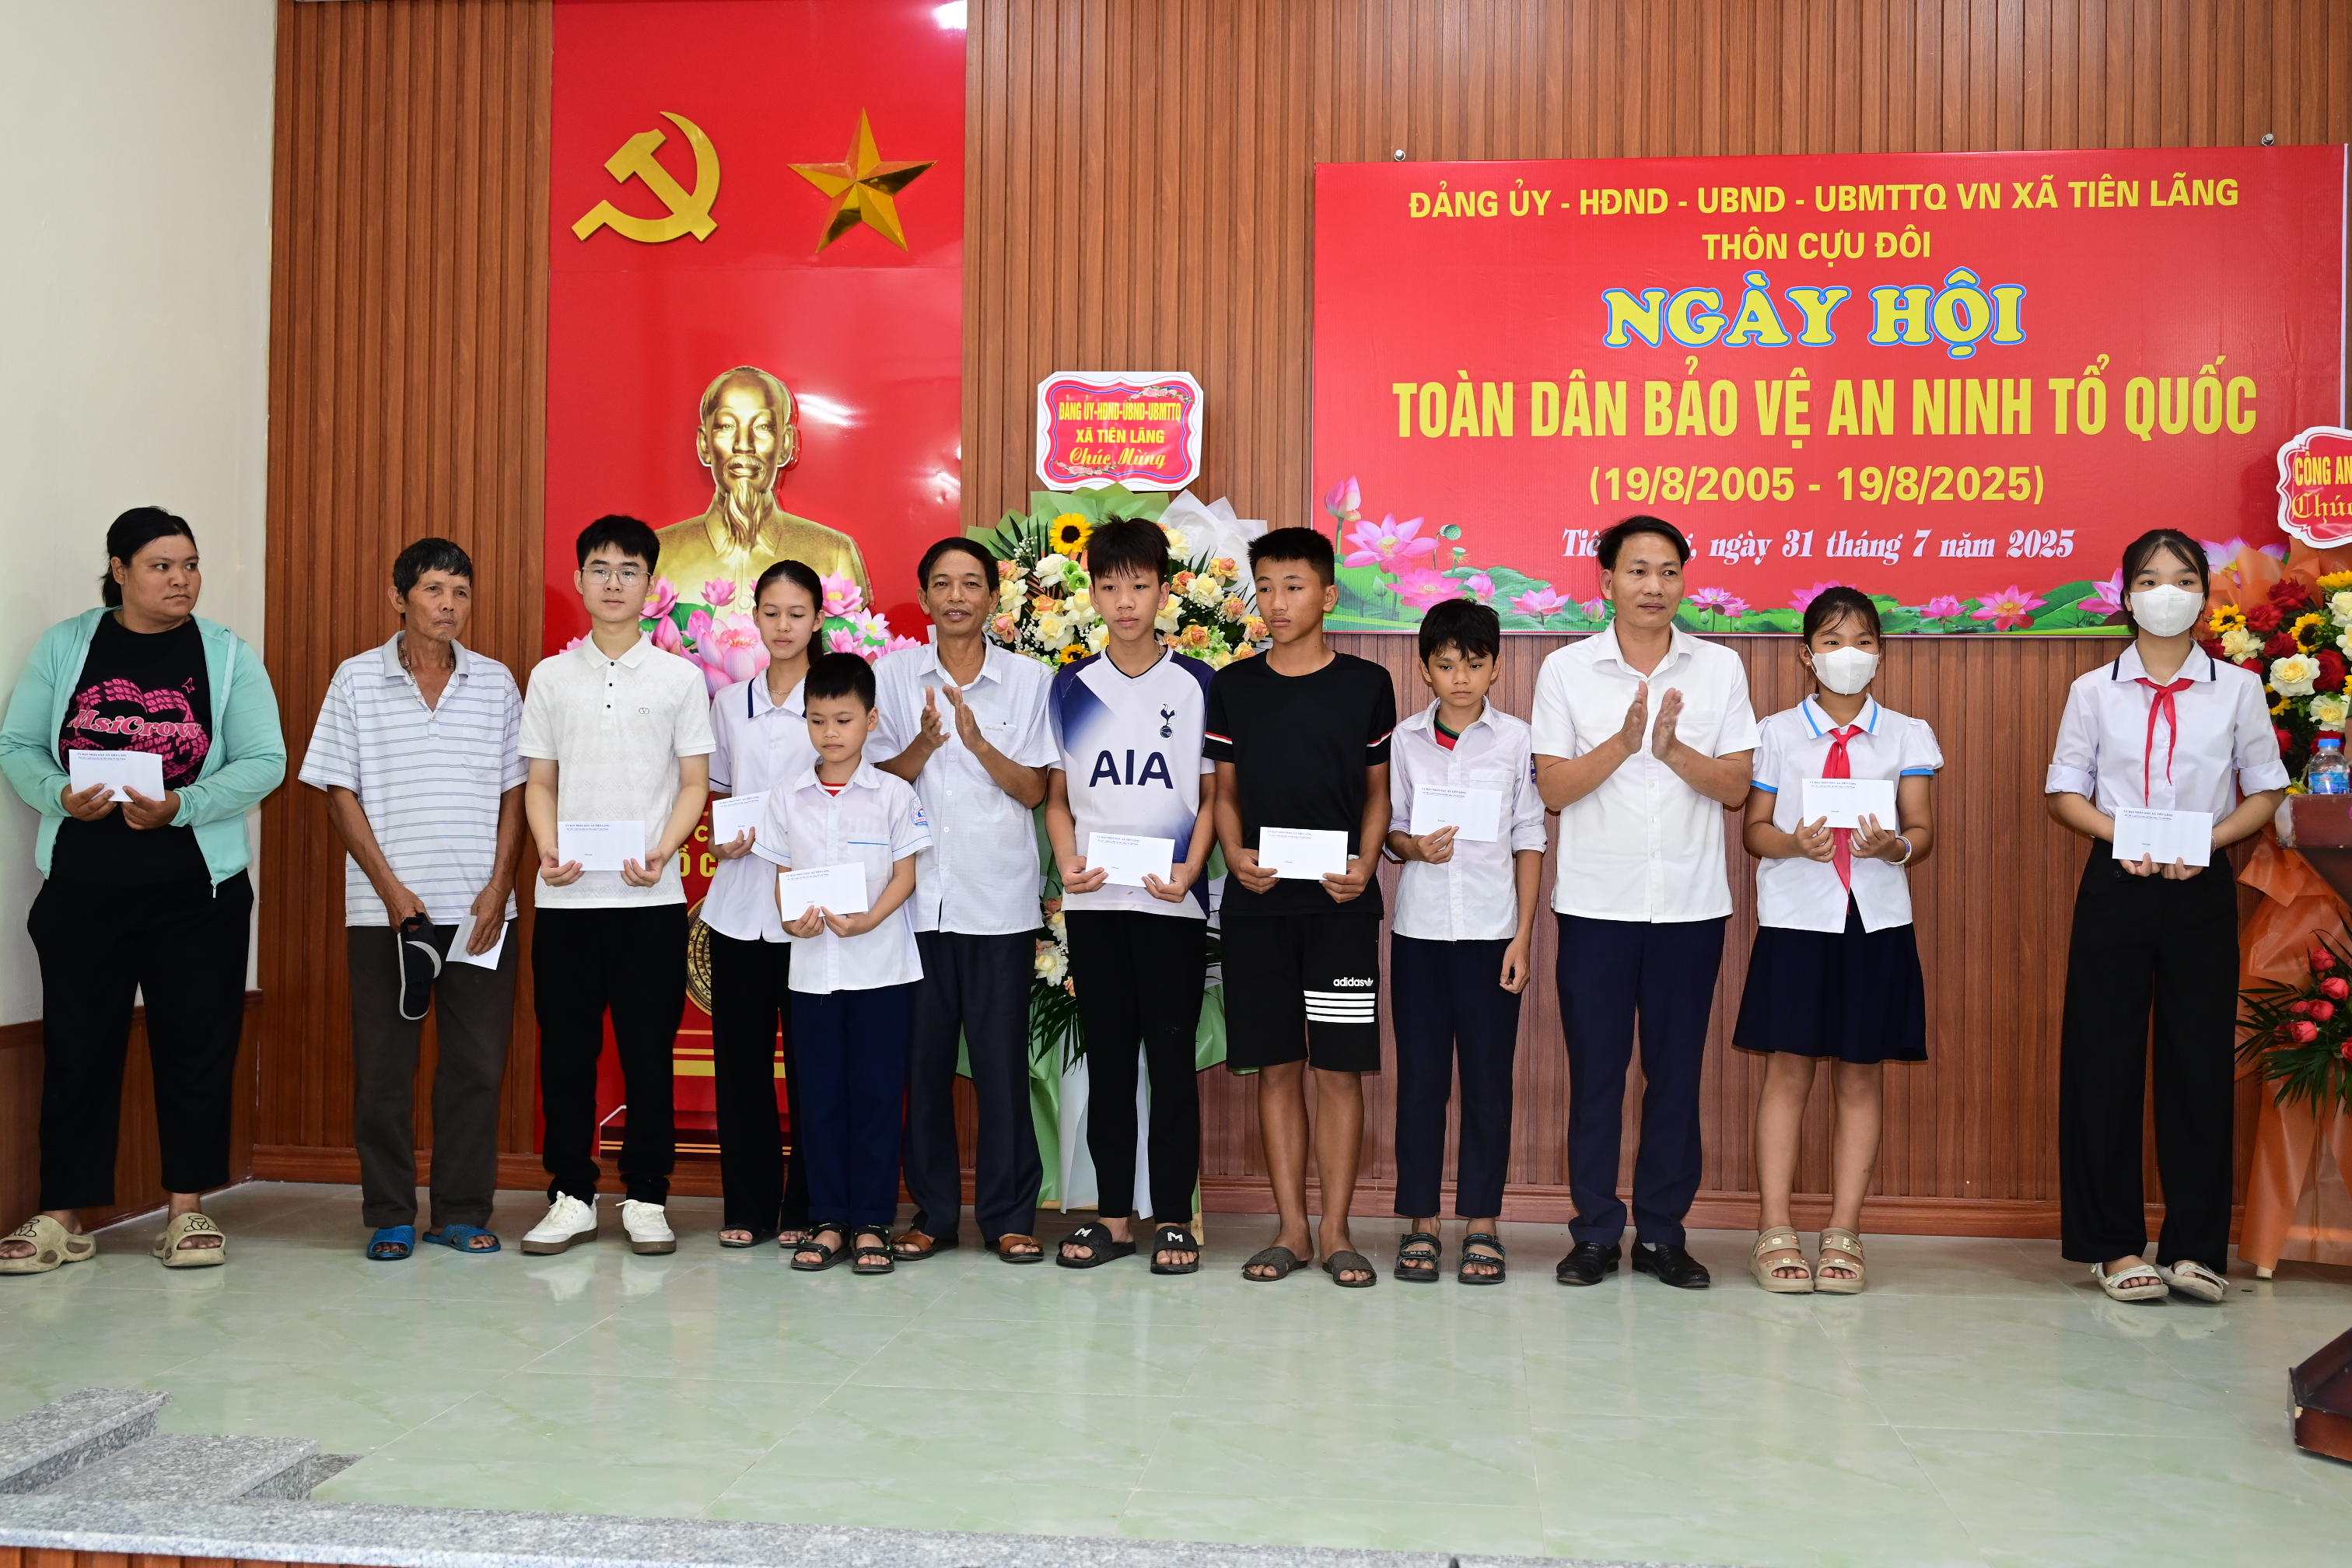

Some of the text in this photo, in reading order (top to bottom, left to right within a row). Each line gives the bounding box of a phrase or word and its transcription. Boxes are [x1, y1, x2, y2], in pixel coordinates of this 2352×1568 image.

[1408, 180, 1498, 218] ĐẢNG
[1509, 178, 1552, 217] ỦY
[1580, 187, 1668, 215] HĐND
[1698, 186, 1786, 214] UBND
[1815, 183, 1947, 212] UBMTTQ
[1956, 183, 2001, 209] VN
[2011, 174, 2059, 209] XÃ
[2067, 173, 2139, 208] TIÊN
[2151, 172, 2239, 207] LÃNG
[1701, 224, 1931, 268] THÔN CỰU ĐÔI
[1602, 266, 2027, 359] NGÀY HỘI
[1059, 394, 1082, 421] ĐẢNG
[1392, 353, 2257, 449] TOÀN DÂN BẢO VỆ AN NINH TỔ QUỐC
[1075, 426, 1165, 443] XÃ TIÊN LÃNG
[1069, 447, 1111, 465] Chúc
[2294, 450, 2352, 486] CÔNG AN
[1590, 466, 1794, 505] (19/8/2005
[1837, 465, 2044, 506] 19/8/2025)
[1562, 528, 1602, 557] Tiê
[1709, 530, 1773, 565] ngày
[1782, 529, 1814, 558] 31
[1826, 530, 1902, 565] tháng
[1913, 529, 1932, 557] 7
[1939, 532, 1996, 558] năm
[2006, 529, 2075, 558] 2025
[1089, 749, 1174, 789] AIA
[1333, 977, 1364, 987] adidas
